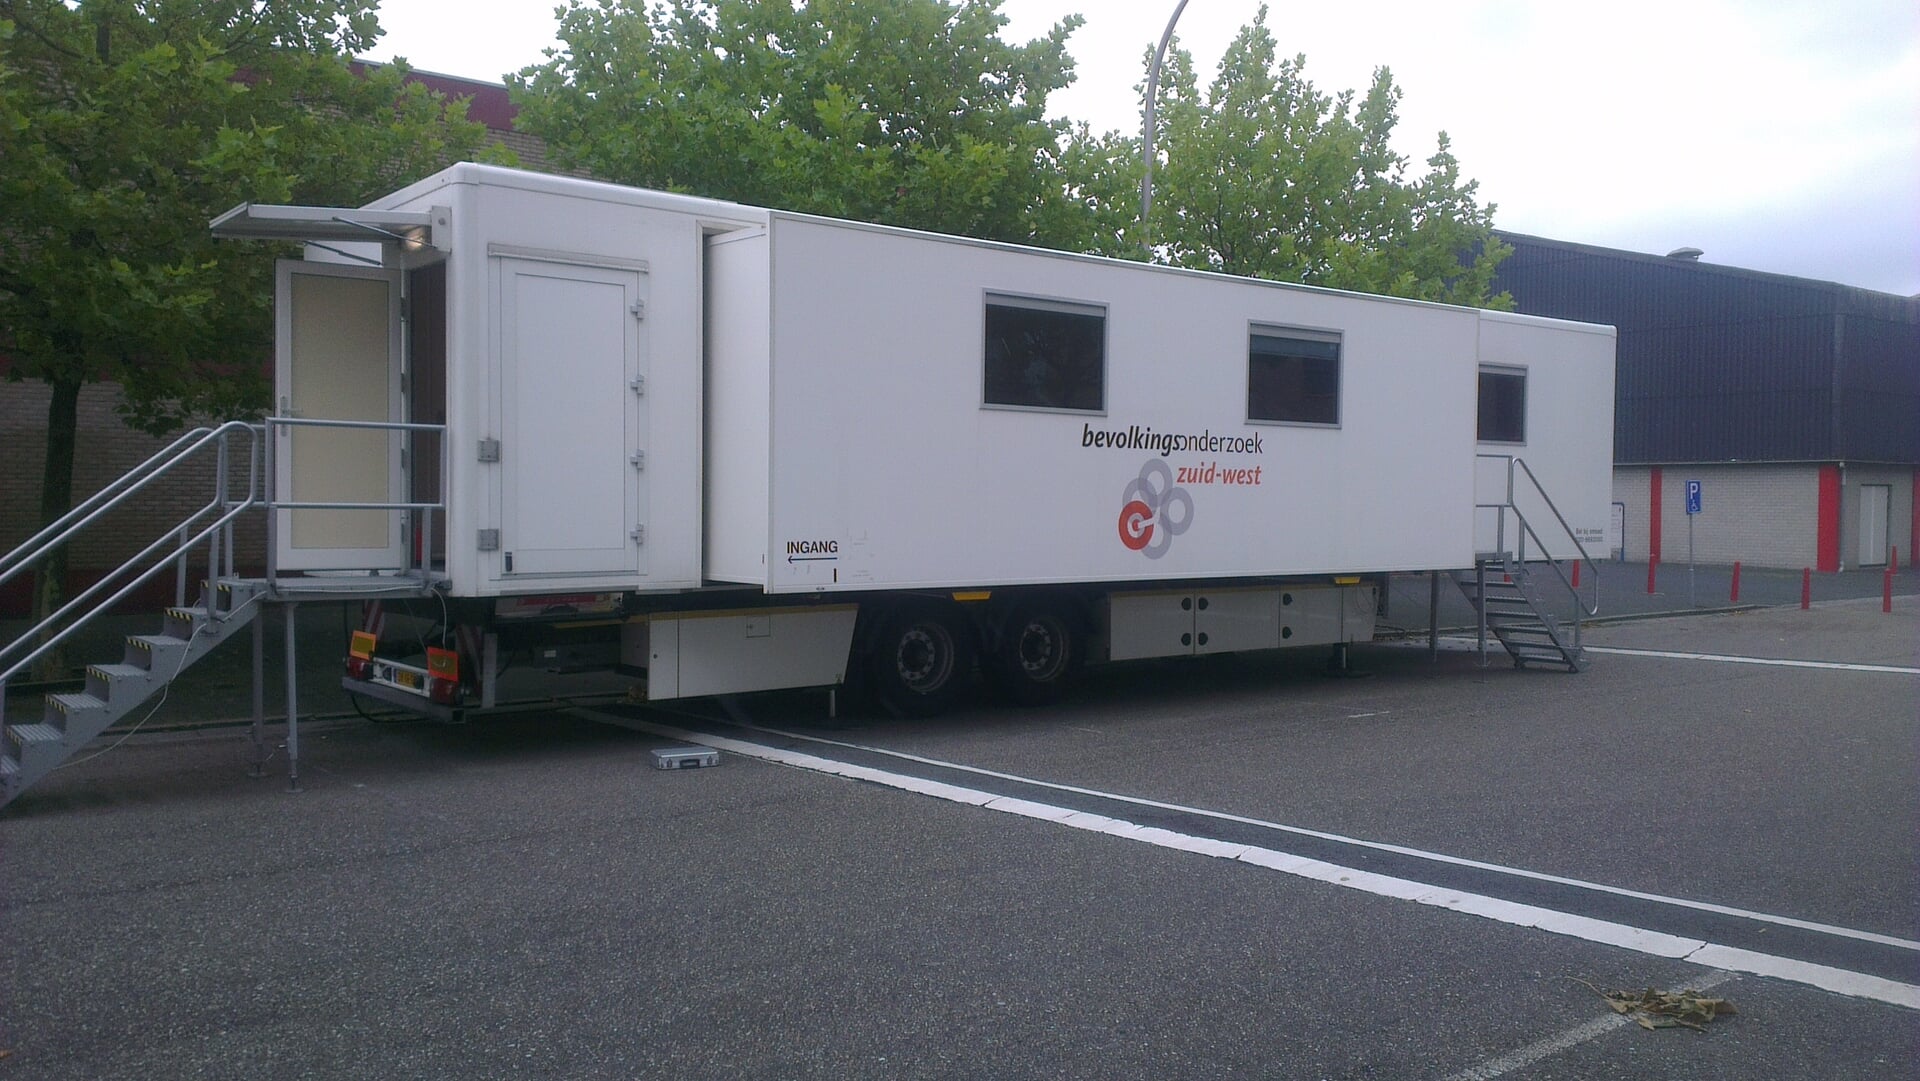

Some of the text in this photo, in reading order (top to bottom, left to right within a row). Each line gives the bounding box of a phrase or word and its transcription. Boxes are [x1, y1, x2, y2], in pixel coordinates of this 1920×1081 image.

[1082, 423, 1263, 456] bevolkingsonderzoek
[1176, 462, 1262, 485] zuid-west
[1689, 482, 1699, 500] P
[786, 540, 838, 554] INGANG
